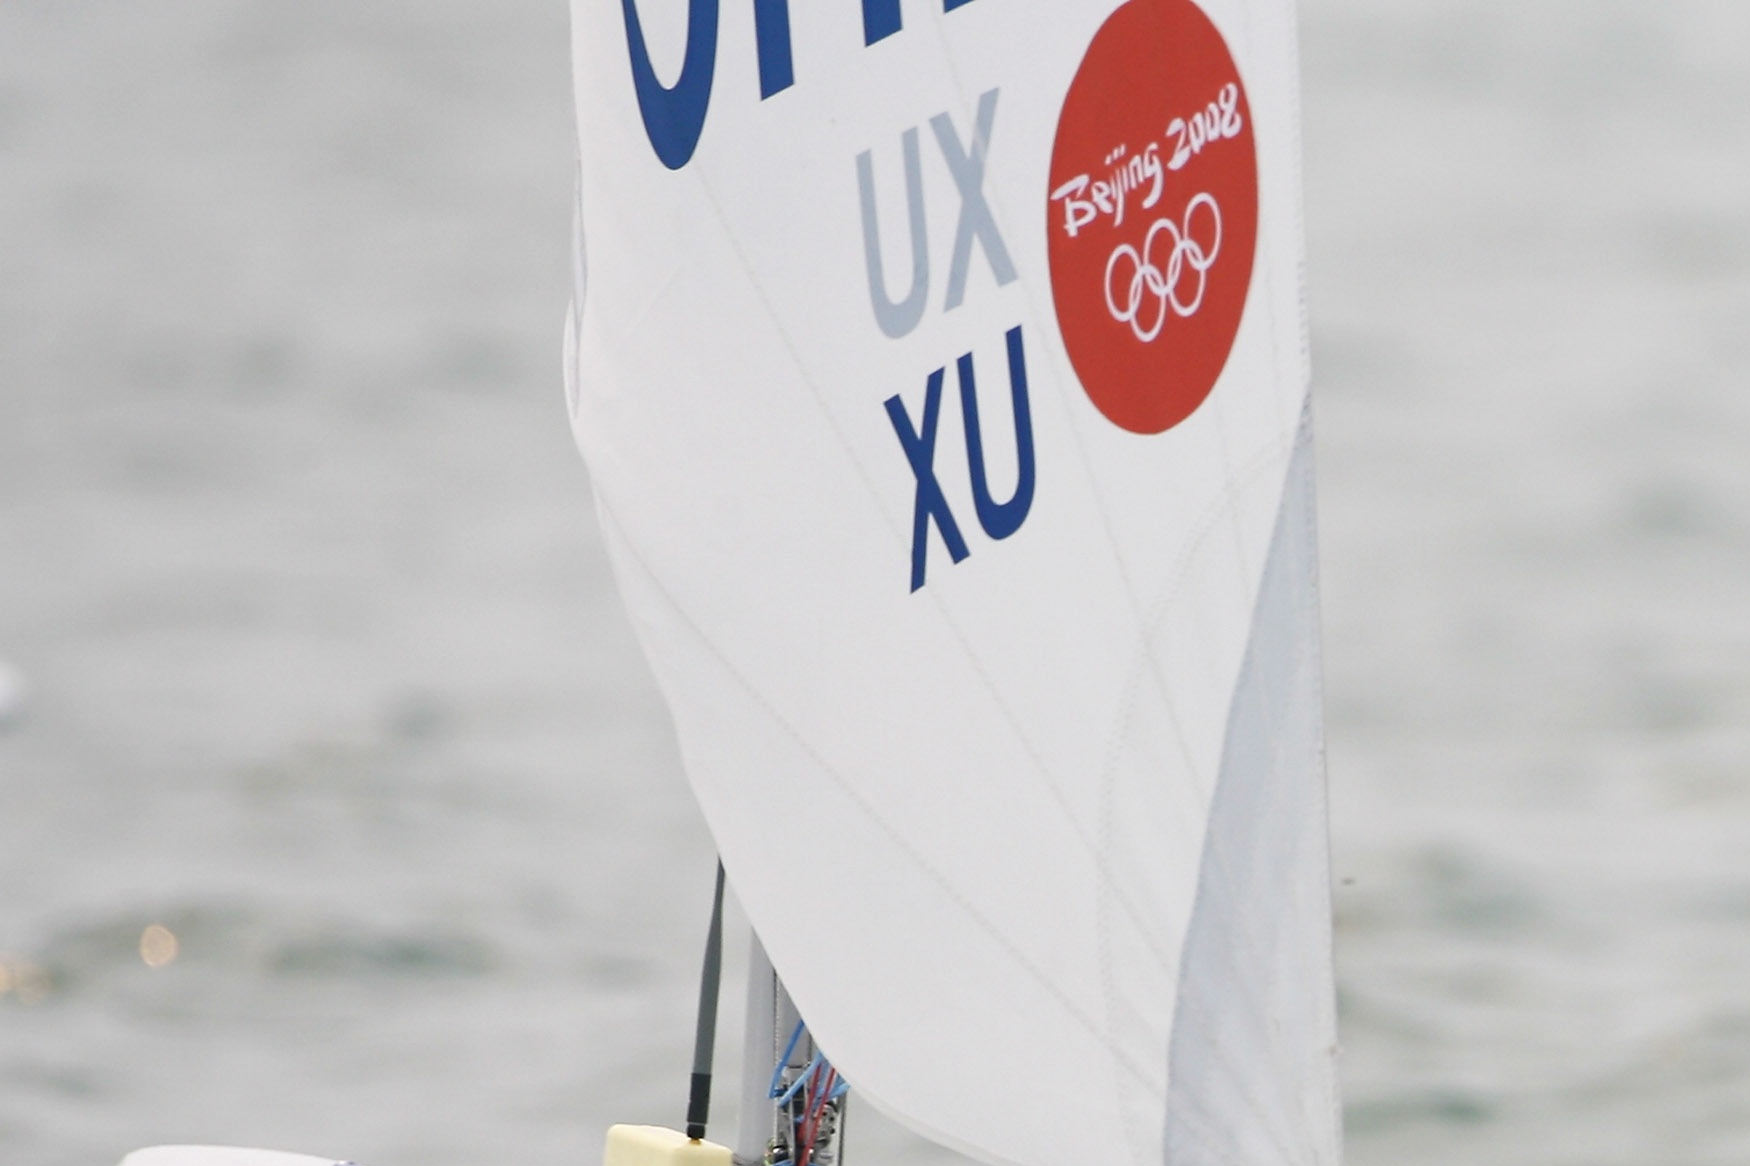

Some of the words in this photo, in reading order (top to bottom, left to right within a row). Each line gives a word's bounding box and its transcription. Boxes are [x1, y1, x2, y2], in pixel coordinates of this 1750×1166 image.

[1050, 142, 1163, 238] Beijing
[1166, 82, 1243, 171] 2008
[883, 324, 1036, 594] XU
